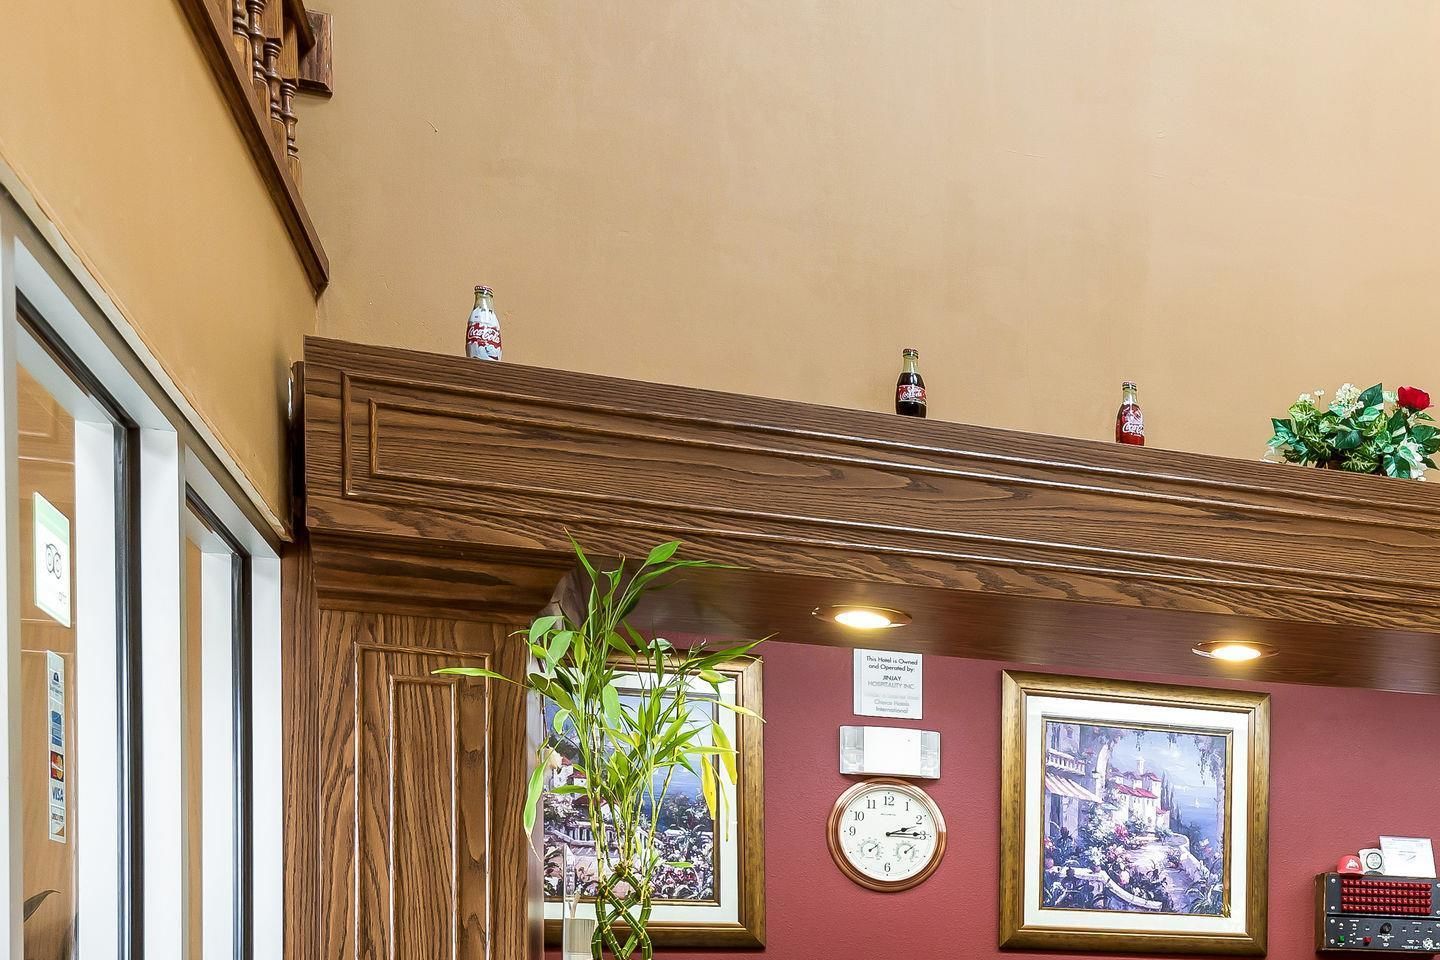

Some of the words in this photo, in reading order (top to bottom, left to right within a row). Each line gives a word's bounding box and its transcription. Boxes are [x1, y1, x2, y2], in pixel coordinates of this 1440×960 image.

[52, 785, 64, 803] VISA
[867, 799, 876, 809] 11
[884, 796, 895, 806] 12
[905, 801, 909, 811] 1
[854, 811, 865, 821] 10
[916, 815, 923, 825] 2
[849, 826, 856, 836] 9
[884, 862, 891, 872] 6
